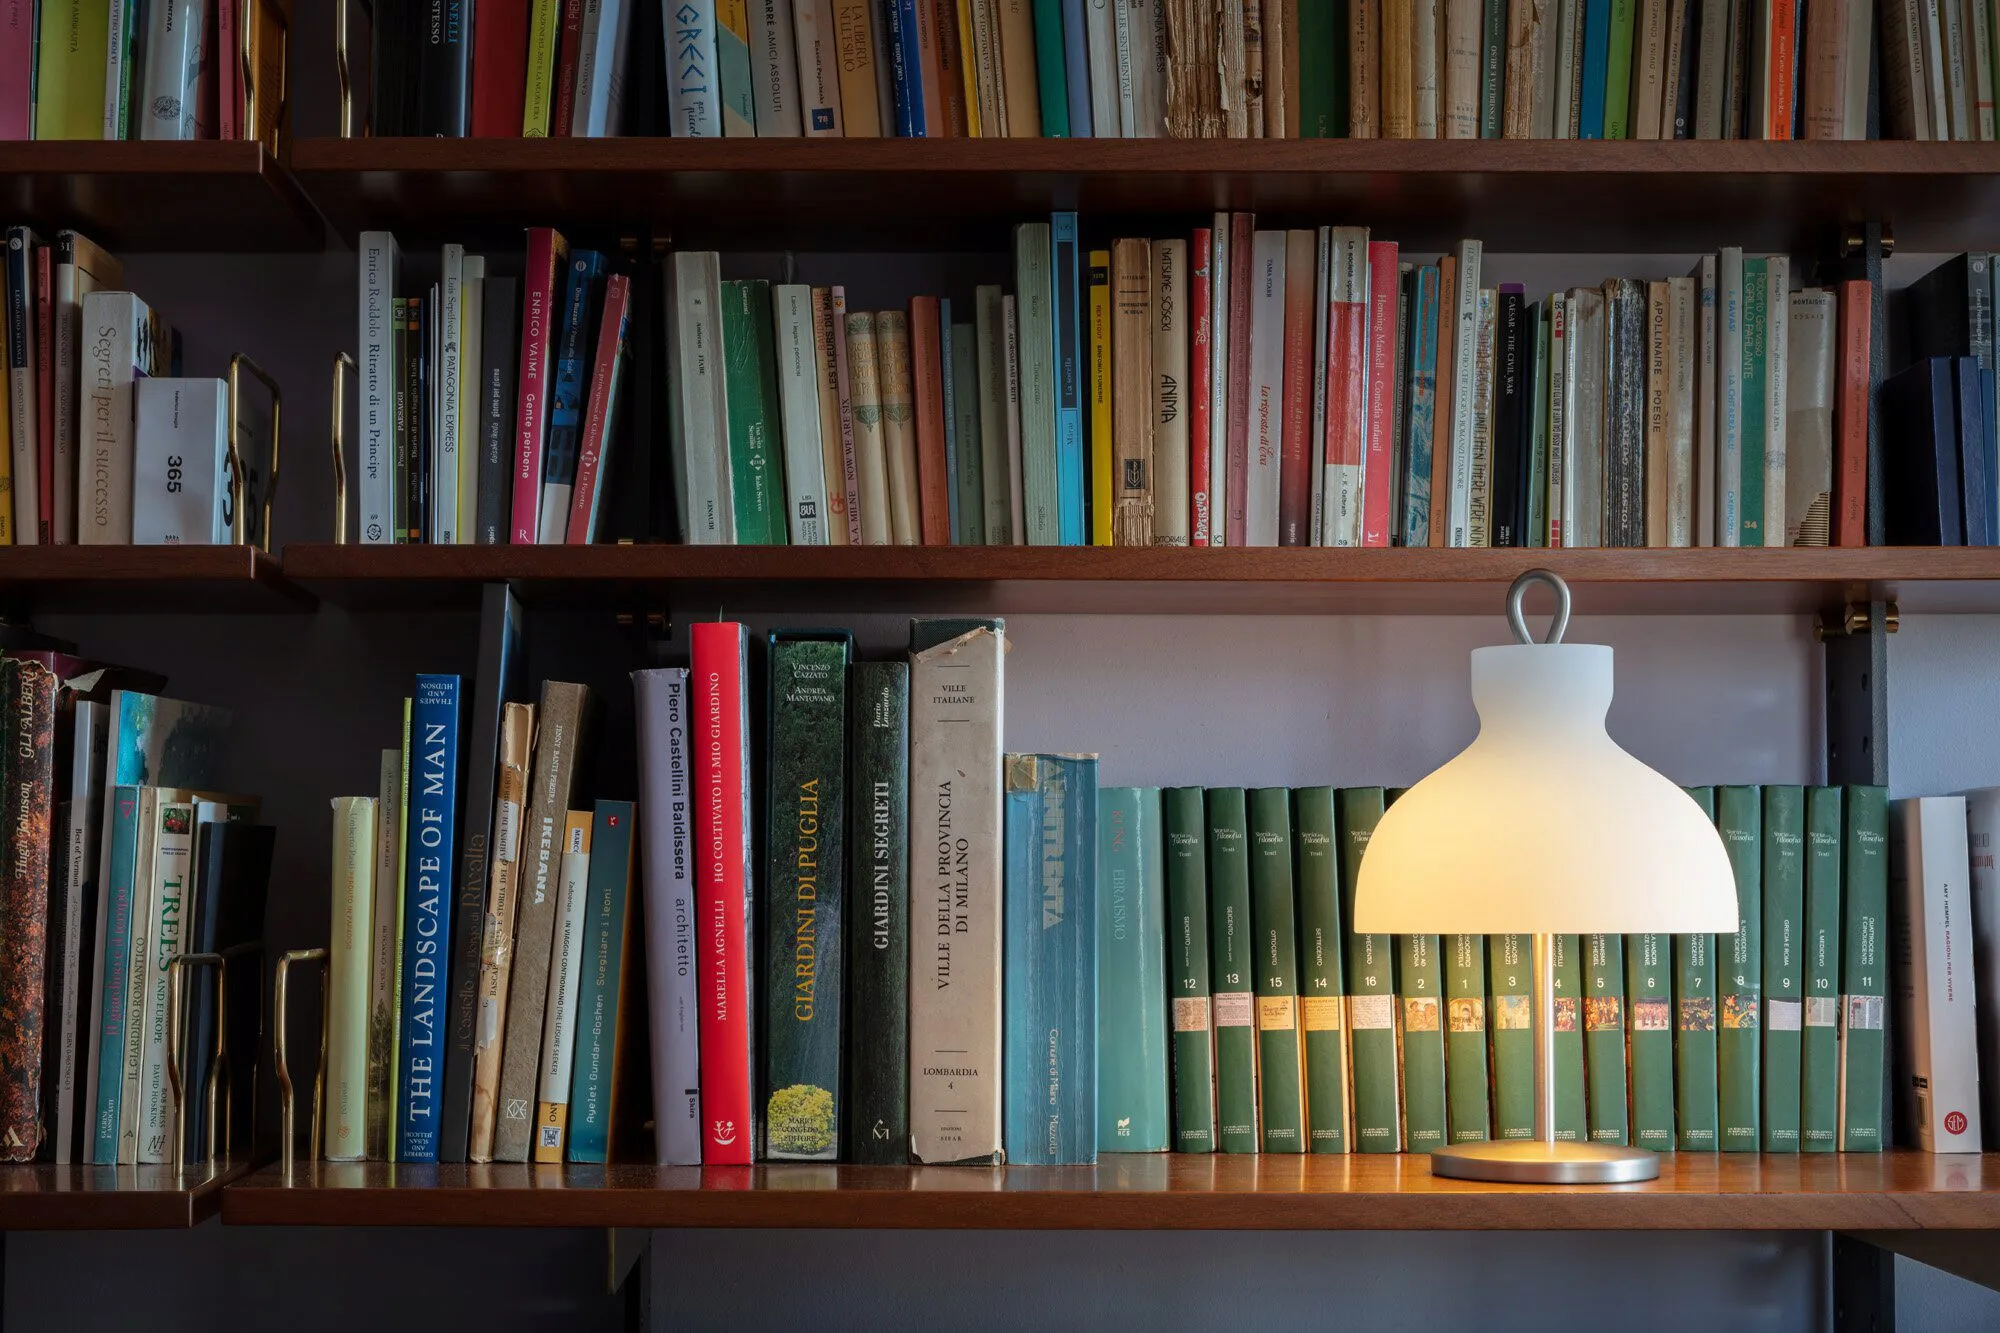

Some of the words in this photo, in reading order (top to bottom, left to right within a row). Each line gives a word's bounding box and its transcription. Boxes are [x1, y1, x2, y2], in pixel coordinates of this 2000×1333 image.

[852, 5, 863, 20] LA
[676, 5, 706, 94] GRECI
[767, 30, 778, 60] AMICI
[840, 7, 856, 72] NELL'ESILIO
[854, 25, 870, 68] LIBERTÀ
[1120, 30, 1130, 98] SENTIMENTALE
[770, 64, 782, 112] ASSOLUTI
[369, 248, 379, 284] Enrica
[1161, 248, 1172, 292] NATSUME
[1745, 272, 1753, 283] IL
[447, 277, 456, 294] Luis
[1755, 272, 1766, 312] Roberto
[368, 288, 379, 337] Roddolo
[446, 296, 456, 339] Sepúlveda
[529, 292, 541, 336] ENRICO
[1375, 294, 1386, 331] Henning
[1508, 296, 1516, 328] CAESAR
[1744, 284, 1754, 320] GRILLO
[1375, 334, 1385, 368] Mankell
[1507, 335, 1515, 350] THE
[1654, 300, 1662, 375] APOLLINAIRE
[1743, 324, 1753, 378] PARLANTE
[1754, 315, 1765, 356] Gervaso
[93, 326, 117, 391] Segreti
[368, 344, 379, 392] Ritratto
[527, 343, 538, 379] VAIME
[1506, 353, 1514, 374] CIVIL
[445, 356, 456, 411] PATAGONIA
[1160, 374, 1177, 423] ANIMA
[1373, 380, 1384, 418] Comédia
[1506, 376, 1514, 395] WAR
[92, 396, 112, 426] per
[368, 395, 379, 407] di
[524, 394, 535, 428] Gente
[842, 399, 850, 413] SIX
[1258, 394, 1270, 433] risposta
[1652, 390, 1661, 433] POESIE
[368, 410, 377, 426] un
[445, 414, 455, 452] EXPRESS
[844, 417, 852, 434] ARE
[96, 431, 116, 444] il
[846, 439, 853, 455] WE
[1260, 436, 1269, 445] di
[1373, 421, 1383, 451] infantil
[368, 430, 379, 479] Principe
[521, 432, 532, 478] perbene
[847, 458, 855, 480] NOW
[1259, 446, 1273, 467] Eva
[94, 449, 109, 526] successo
[167, 456, 182, 493] 365
[849, 491, 857, 522] MILNE
[1195, 492, 1207, 540] PAPERINO
[793, 663, 830, 673] VINCENZO
[794, 671, 827, 679] CAZZATO
[669, 683, 682, 722] Piero
[787, 693, 834, 703] MANTOVANO
[795, 686, 826, 694] ANDREA
[933, 695, 974, 704] ITALIANE
[942, 684, 966, 693] VILLE
[710, 672, 720, 739] GIARDINO
[554, 725, 562, 746] JENNY
[423, 723, 447, 794] MAN
[551, 750, 560, 773] BANTI
[670, 727, 684, 797] Castellini
[712, 742, 722, 768] MIO
[547, 775, 557, 803] PEREIRA
[712, 773, 722, 782] IL
[74, 828, 83, 843] Best
[421, 809, 442, 848] OF
[712, 787, 722, 864] COLTIVATO
[798, 778, 820, 868] PUGLIA
[874, 782, 889, 858] SEGRETI
[938, 781, 952, 876] PROVINCIA
[673, 801, 687, 880] Baldissera
[73, 857, 82, 887] Vermont
[533, 817, 553, 904] IKEBANA
[714, 868, 724, 882] HO
[956, 838, 968, 898] MILANO
[602, 889, 612, 918] leoni
[797, 876, 818, 900] DI
[874, 865, 889, 950] GIARDINI
[938, 883, 951, 936] DELLA
[956, 908, 968, 933] DI
[1114, 870, 1126, 939] EBRAISMO
[159, 876, 184, 972] TREES
[676, 898, 690, 976] architetto
[715, 900, 726, 957] AGNELLI
[414, 856, 439, 1046] LANDSCAPE
[595, 933, 609, 986] Svegliare
[796, 908, 816, 1021] GIARDINI
[938, 943, 950, 990] VILLE
[133, 938, 146, 1003] ROMANTICO
[1183, 979, 1195, 988] 12
[1226, 974, 1239, 983] 13
[1270, 978, 1282, 987] 15
[1315, 978, 1327, 987] 14
[1365, 977, 1376, 986] 16
[1418, 978, 1424, 988] 2
[1463, 979, 1467, 988] 1
[1509, 977, 1516, 986] 3
[1555, 978, 1561, 988] 4
[1597, 978, 1604, 987] 5
[1648, 978, 1654, 987] 6
[1695, 978, 1701, 987] 7
[1737, 976, 1744, 985] 8
[1783, 978, 1789, 987] 9
[1816, 979, 1827, 988] 10
[1863, 977, 1871, 986] 11
[155, 978, 165, 1001] AND
[716, 962, 726, 1020] MARELLA
[129, 1007, 142, 1065] GIARDINO
[153, 1004, 164, 1044] EUROPE
[589, 995, 604, 1079] Gundar-Goshen
[1050, 1029, 1060, 1060] Comune
[128, 1069, 138, 1080] IL
[151, 1064, 160, 1092] DAVID
[923, 1067, 978, 1076] LOMBARDIA
[1050, 1062, 1059, 1073] di
[159, 1088, 168, 1102] BOB
[410, 1058, 433, 1120] THE
[948, 1082, 953, 1090] 4
[1049, 1076, 1059, 1104] Milano
[149, 1095, 159, 1128] HOSKING
[158, 1105, 167, 1128] PRESS
[586, 1084, 598, 1123] Ayelet
[688, 1098, 696, 1118] Skira
[1048, 1115, 1058, 1154] Mazzotta
